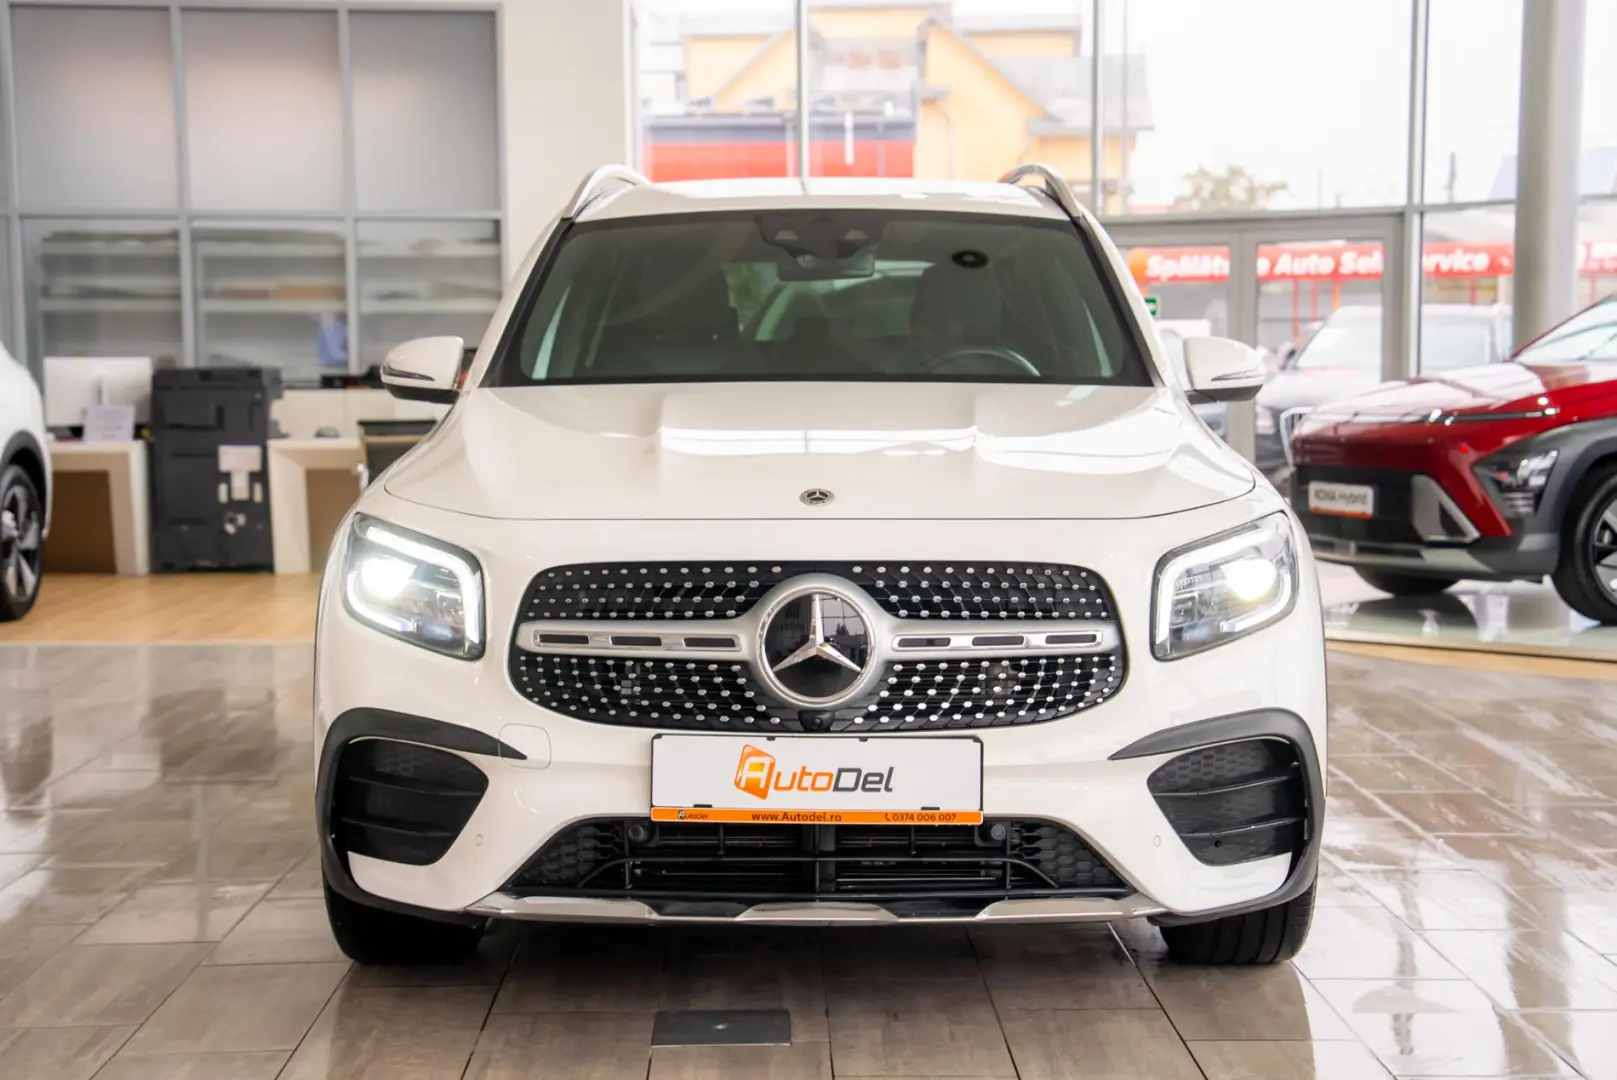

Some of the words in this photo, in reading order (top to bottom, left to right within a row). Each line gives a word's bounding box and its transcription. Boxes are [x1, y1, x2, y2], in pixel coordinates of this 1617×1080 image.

[1273, 252, 1336, 276] Auto
[1338, 250, 1384, 275] Sel
[1422, 248, 1491, 273] rvice
[734, 743, 895, 800] AutoDel
[751, 811, 842, 822] www.Autodel.ro
[892, 813, 915, 822] 0374
[917, 813, 936, 822] 006
[938, 813, 957, 822] 007
